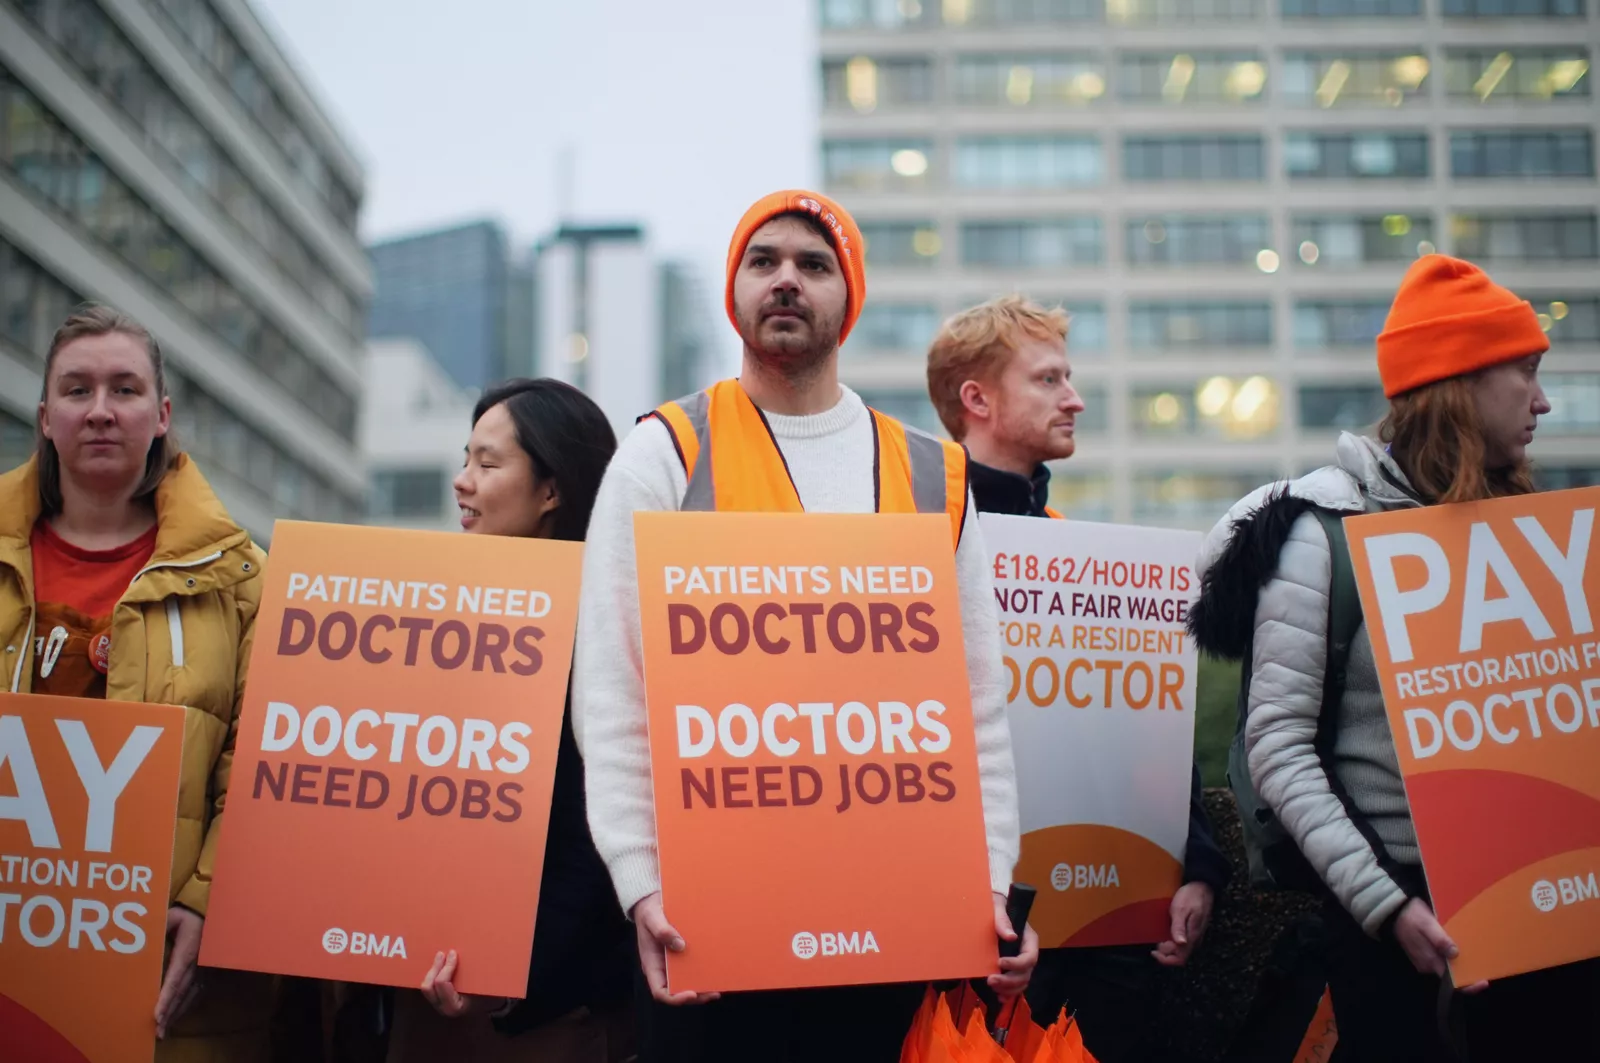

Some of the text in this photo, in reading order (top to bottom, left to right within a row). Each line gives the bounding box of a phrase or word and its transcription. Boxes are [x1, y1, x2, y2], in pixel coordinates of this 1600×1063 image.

[664, 566, 934, 594] PATIENTS NEED
[993, 552, 1190, 591] £18.62/HOUR IS
[1363, 507, 1595, 664] PAY
[286, 573, 551, 619] PATIENTS NEED
[994, 587, 1189, 622] NOT A FAIR WAGE
[277, 607, 546, 676] DOCTORS
[668, 601, 939, 655] DOCTORS
[999, 621, 1187, 654] OR A RESIDENT
[1396, 641, 1600, 699] RESTORATION F
[260, 701, 532, 774] DOCTORS
[675, 700, 951, 758] DOCTORS
[252, 761, 524, 823] NEED JOBS
[681, 761, 956, 813] NEED JOBS
[0, 855, 153, 893] TION FOR
[1074, 863, 1119, 889] BMA
[1558, 872, 1600, 905] BM
[350, 931, 407, 959] BMA
[821, 930, 880, 956] BMA
